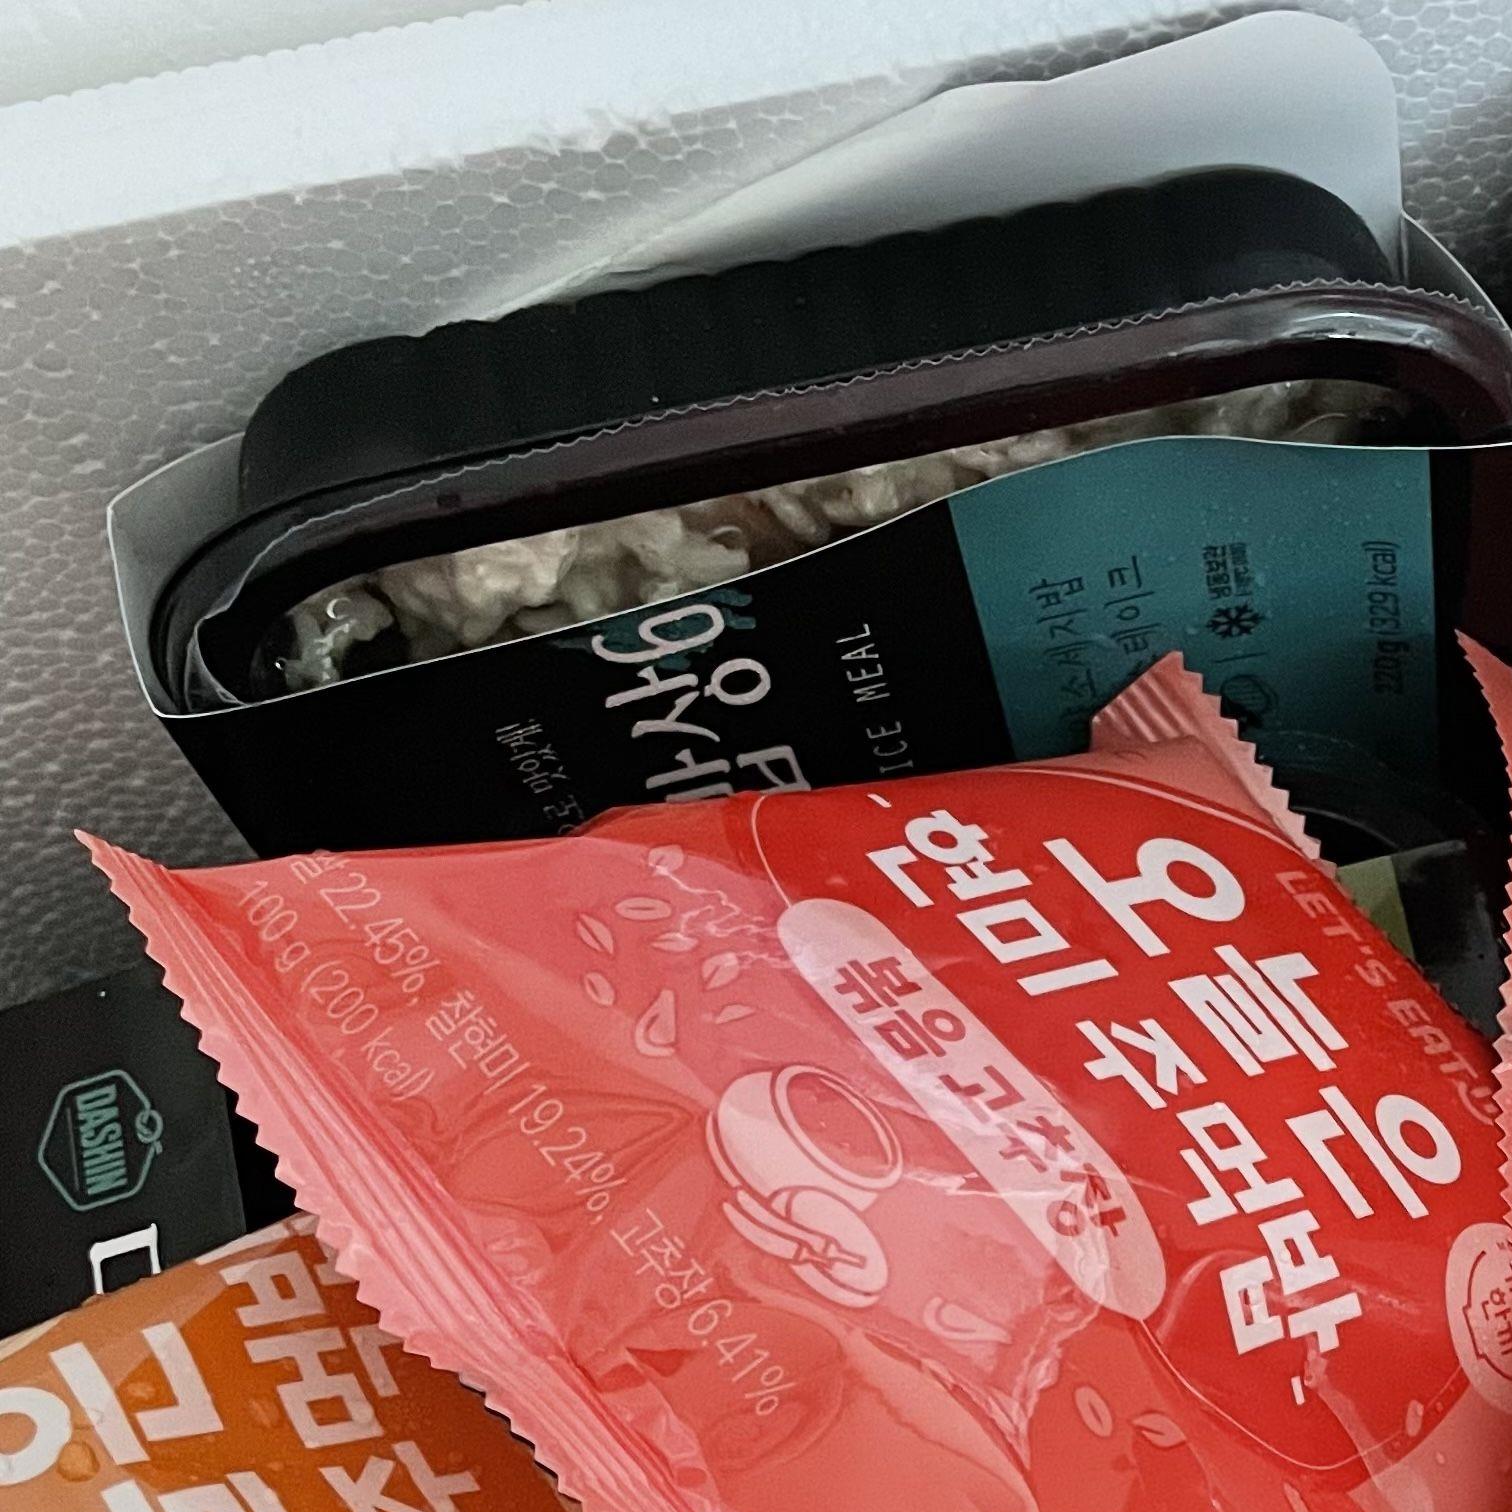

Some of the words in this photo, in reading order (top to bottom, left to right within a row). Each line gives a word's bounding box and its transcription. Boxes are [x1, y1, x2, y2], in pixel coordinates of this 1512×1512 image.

[836, 622, 891, 704] MEAL
[74, 1082, 128, 1197] DASHIN
[238, 881, 295, 940] 100
[302, 961, 375, 1037] (200
[361, 1029, 430, 1101] kcal)
[867, 808, 1362, 1355] 현미주먹밥
[1045, 836, 1462, 1220] 오늘은
[428, 992, 522, 1092] 찰현미
[613, 1208, 707, 1310] 고추장
[689, 1298, 792, 1414] 6.41%
